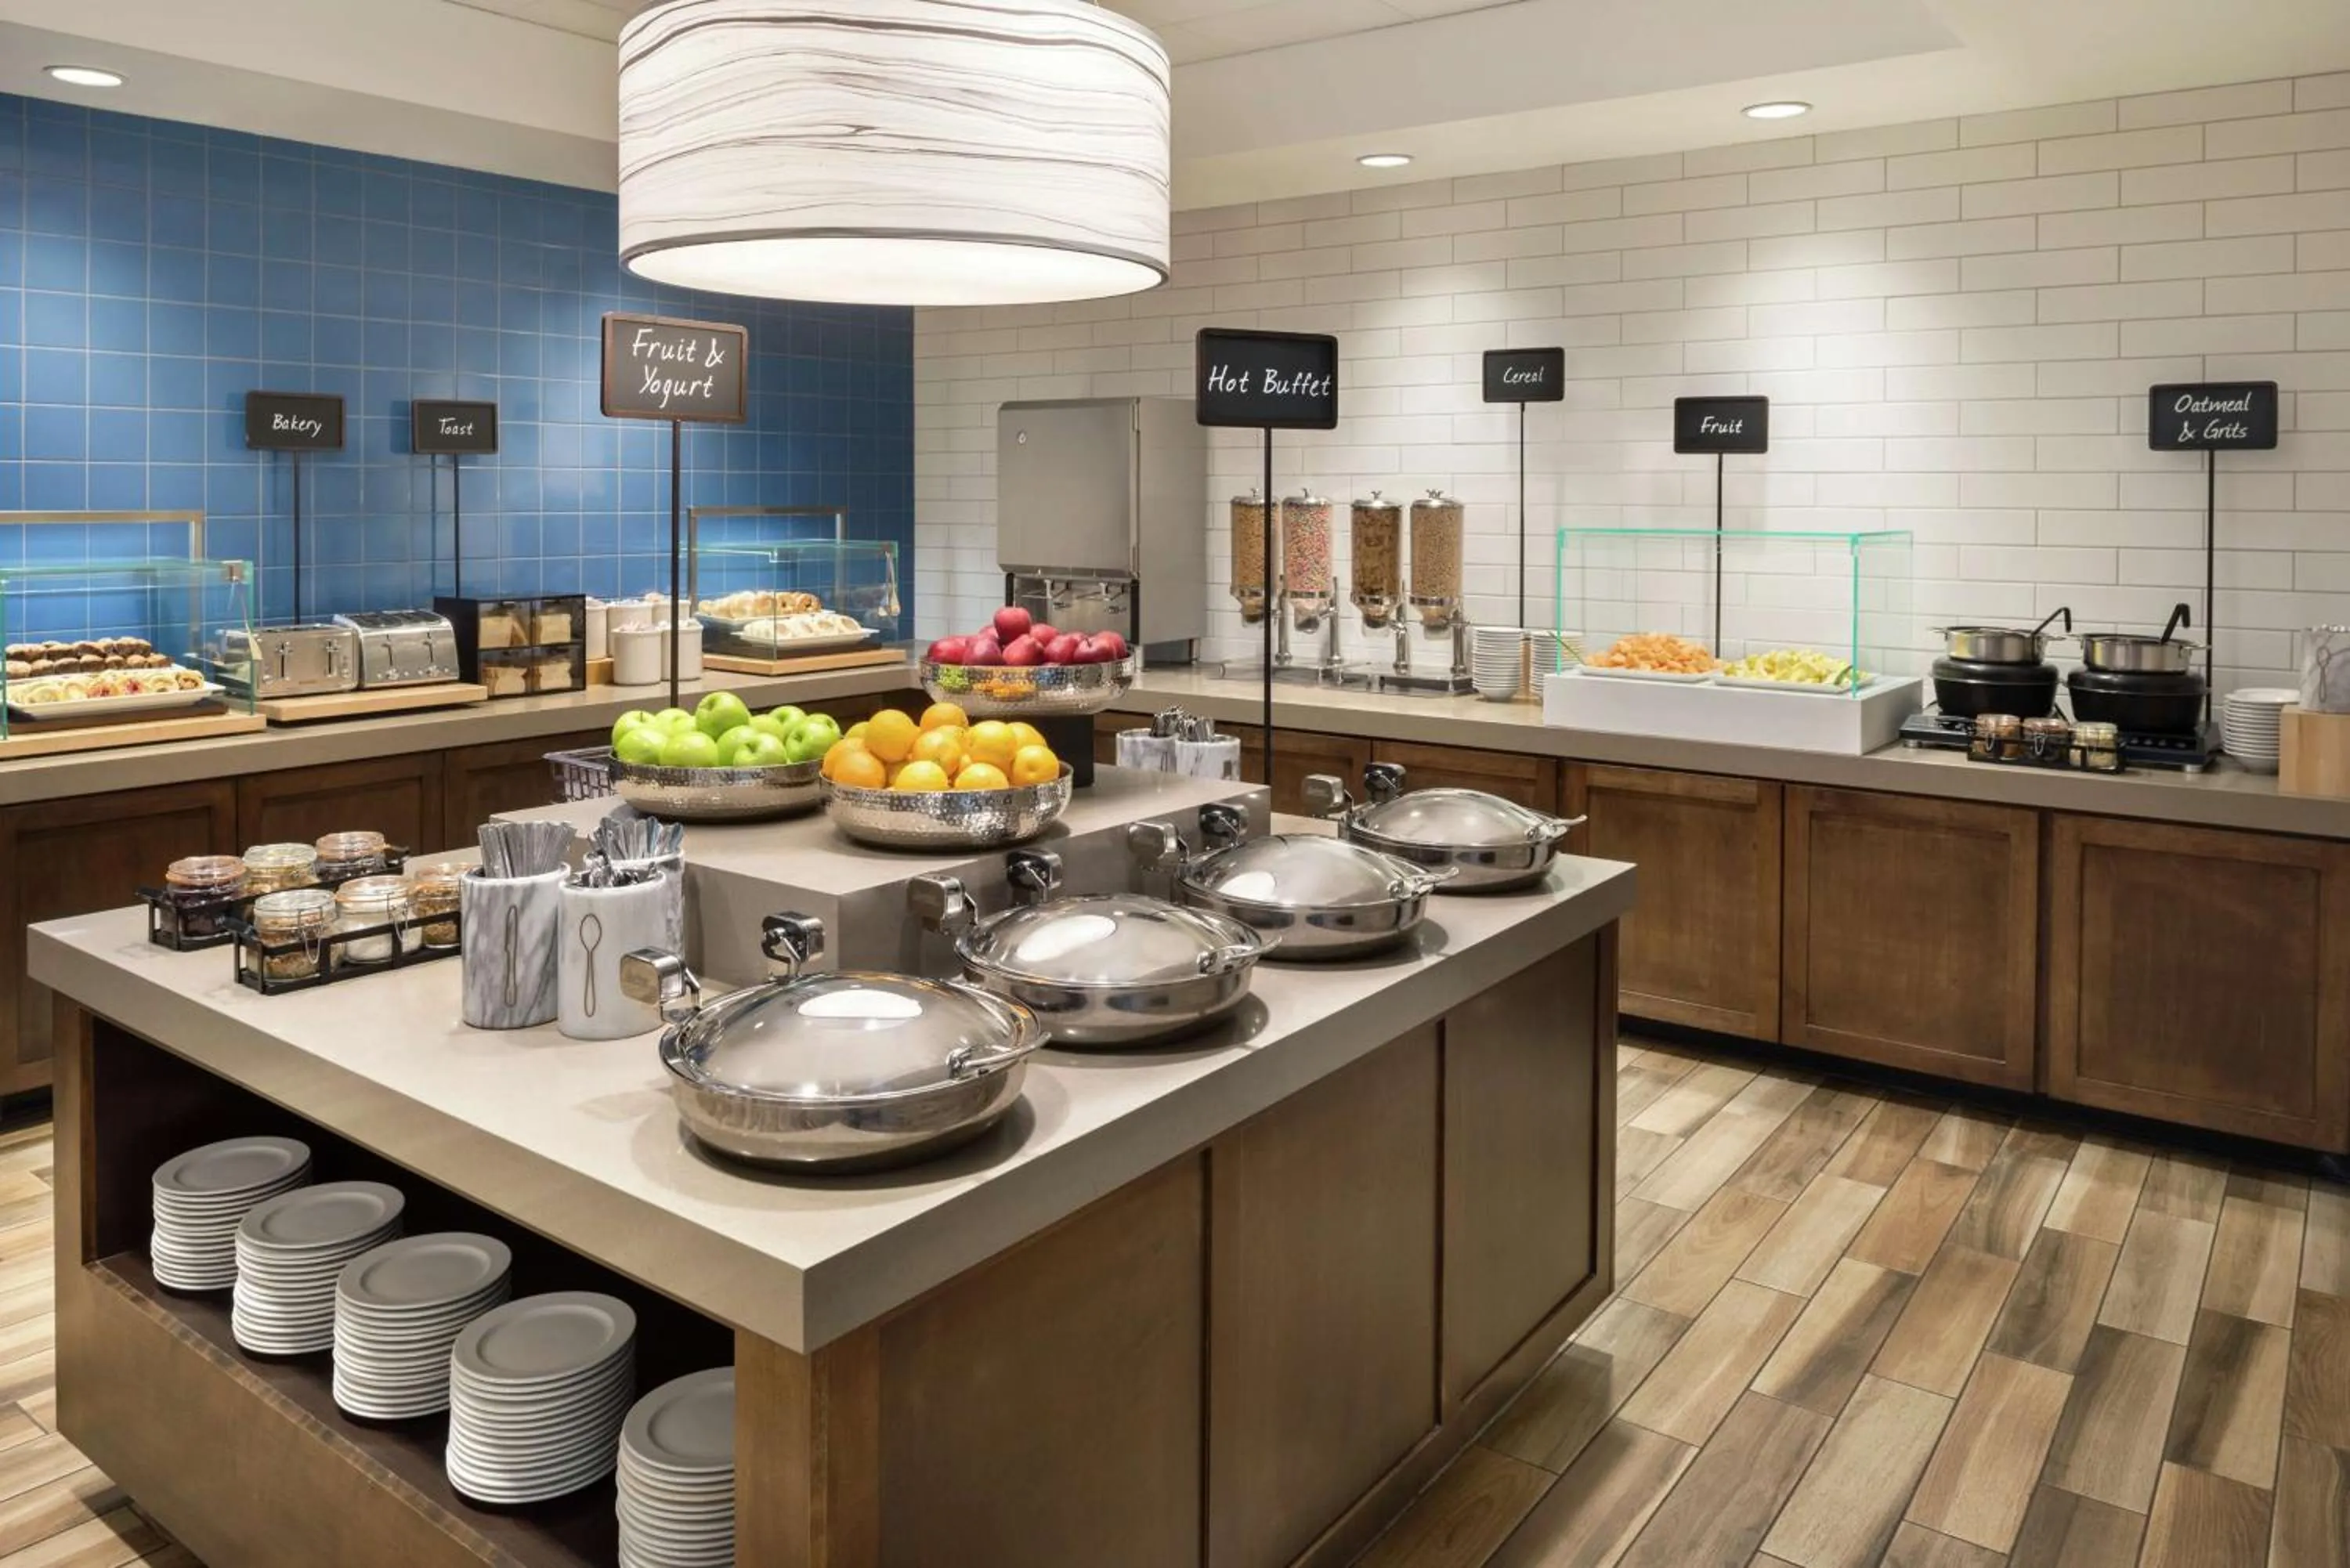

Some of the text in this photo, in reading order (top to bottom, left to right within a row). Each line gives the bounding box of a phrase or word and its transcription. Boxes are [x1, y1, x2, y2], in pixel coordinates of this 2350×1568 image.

[632, 328, 725, 367] Fruit &
[639, 364, 714, 409] Yogurt
[1208, 364, 1331, 396] Hot Buffet
[1503, 366, 1544, 384] Cereal
[2174, 392, 2252, 413] Oatmeal
[272, 413, 323, 438] Bakery
[439, 417, 473, 435] Toast
[1701, 416, 1743, 434] Fruit
[2178, 418, 2248, 443] & Grits
